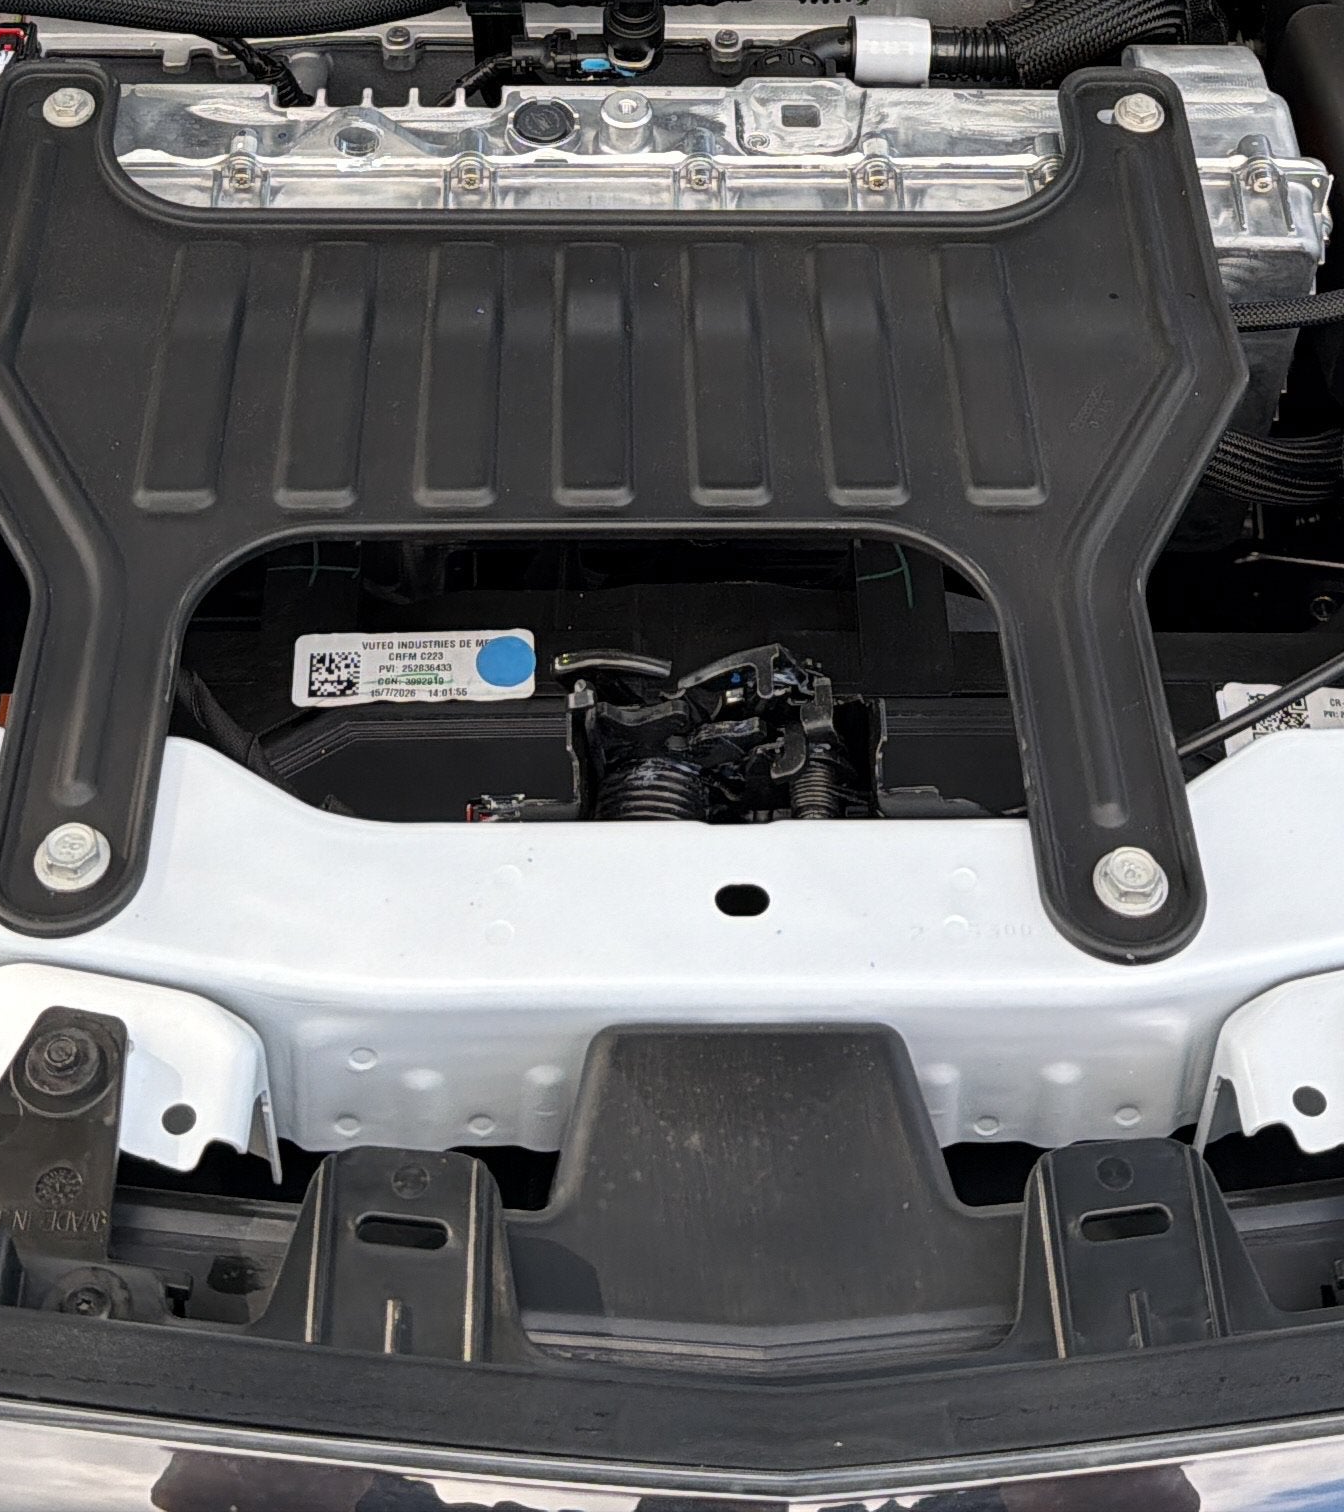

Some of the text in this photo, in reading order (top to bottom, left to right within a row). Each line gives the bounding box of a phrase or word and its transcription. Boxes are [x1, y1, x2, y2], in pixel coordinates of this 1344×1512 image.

[362, 641, 394, 650] VUTEQ
[397, 639, 456, 649] INDUSTRIES
[459, 639, 472, 648] DE
[388, 652, 444, 661] CRFM C223
[401, 663, 453, 672] 252836433
[370, 688, 468, 697] 15/7/2026 14:01:55
